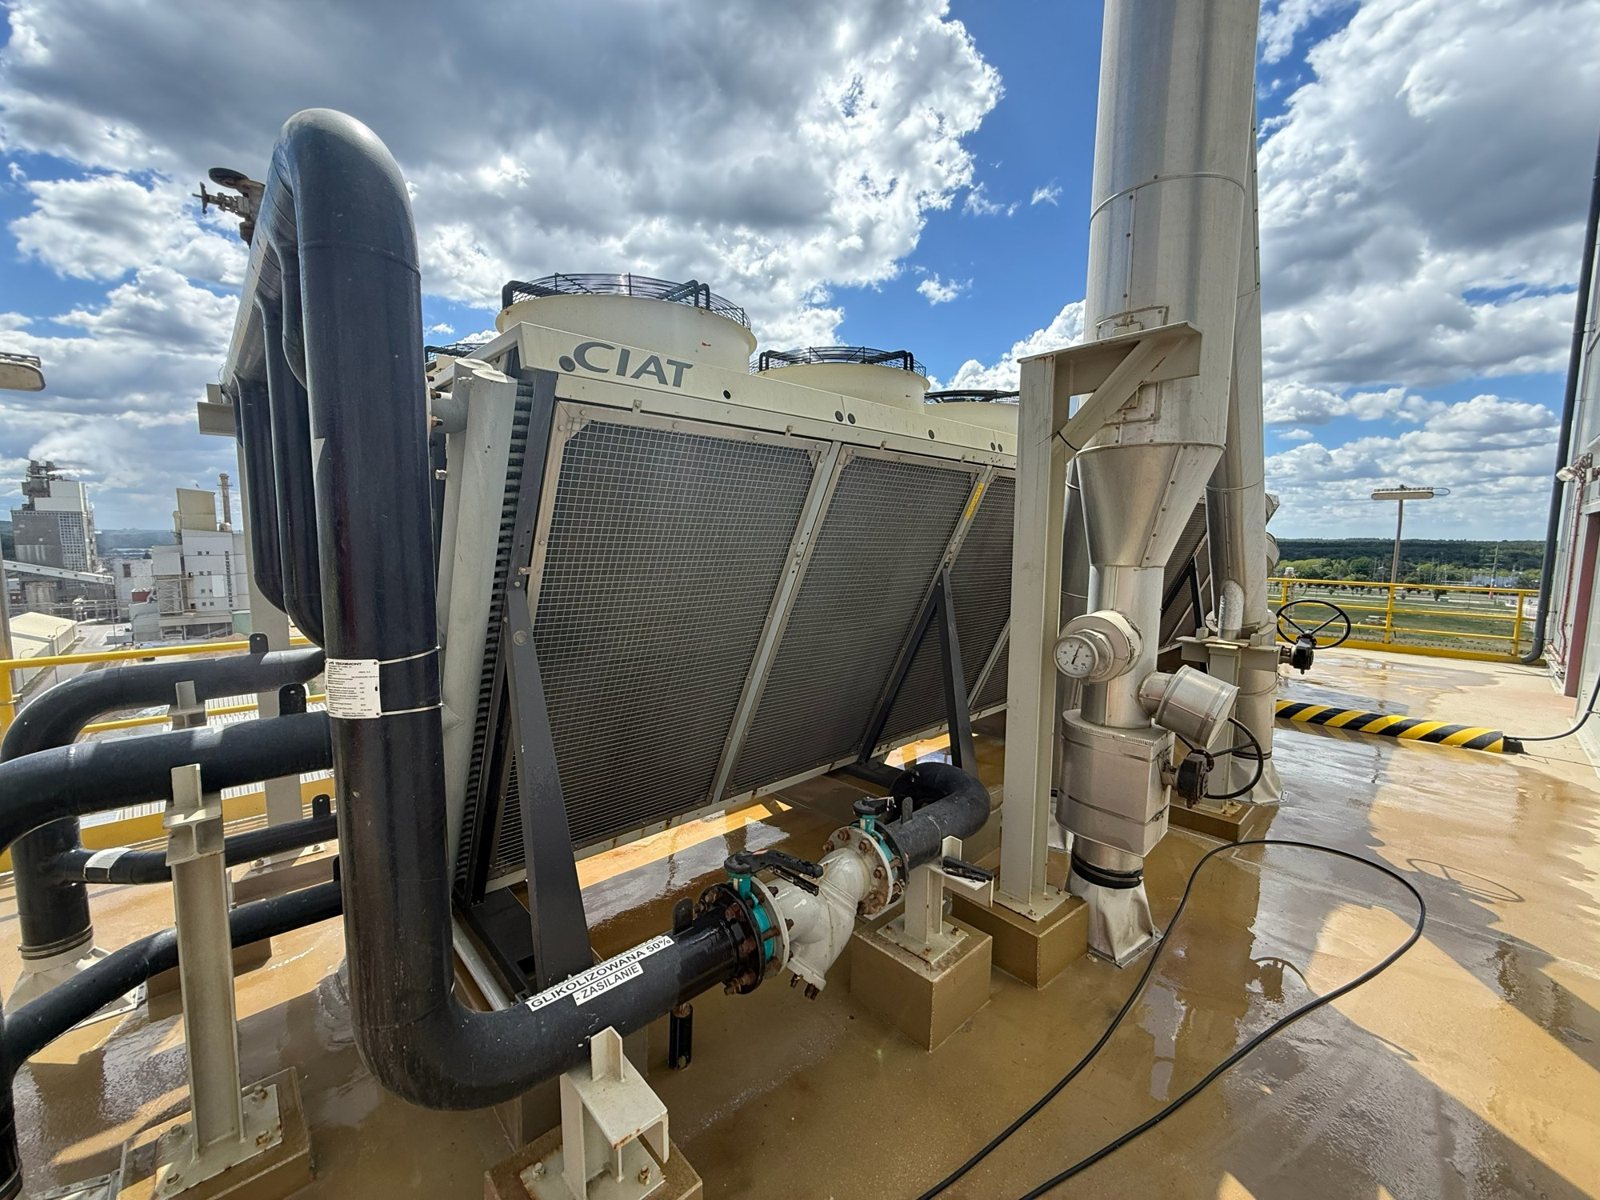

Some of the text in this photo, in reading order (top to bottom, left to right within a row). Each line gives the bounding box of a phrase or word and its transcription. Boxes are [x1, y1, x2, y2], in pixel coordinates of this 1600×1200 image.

[573, 341, 694, 388] CIAT
[531, 938, 672, 1008] GLIKOLIZOWANA 50%
[582, 965, 640, 999] ZASILANIE
